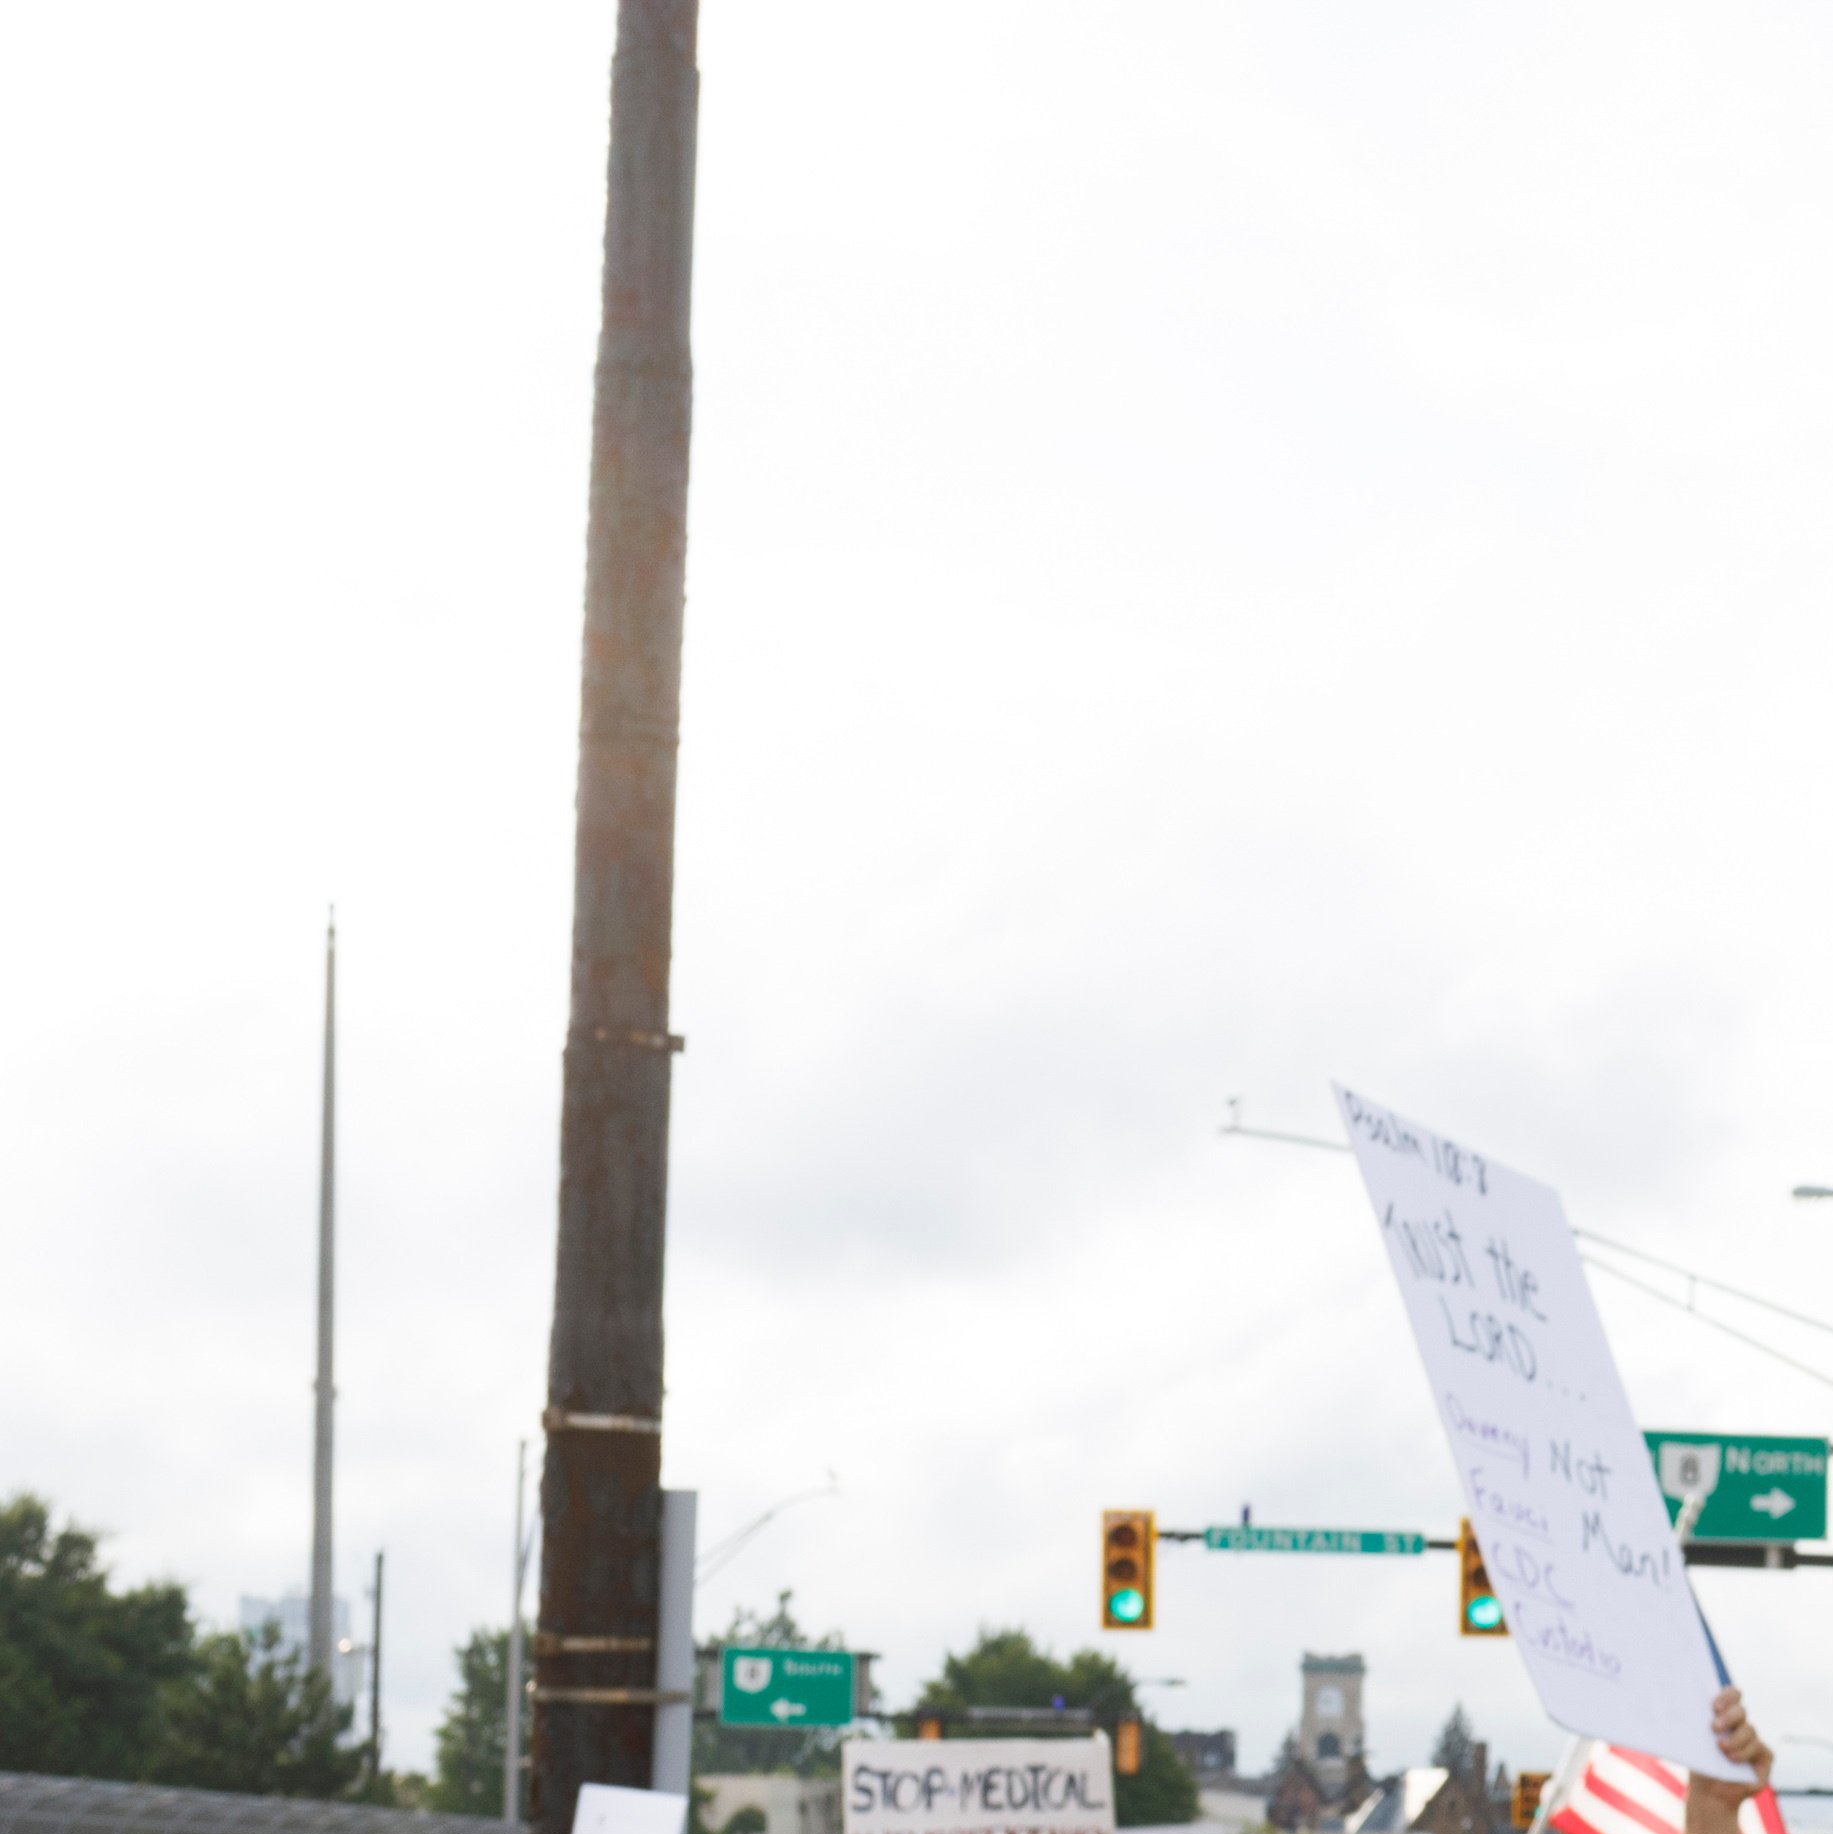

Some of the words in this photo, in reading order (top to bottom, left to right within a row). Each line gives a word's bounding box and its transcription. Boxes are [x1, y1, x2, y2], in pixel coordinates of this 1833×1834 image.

[1345, 1090, 1427, 1167] Psalm
[1486, 1236, 1549, 1323] the
[1549, 1438, 1613, 1503] Not
[1680, 1453, 1699, 1487] 8
[1209, 1528, 1361, 1551] FOUNTAIN
[1384, 1531, 1418, 1553] ST
[1581, 1508, 1671, 1594] Man!
[1491, 1540, 1576, 1611] CDC
[852, 1765, 948, 1812] STOP
[960, 1764, 1106, 1811] MEDICAL
